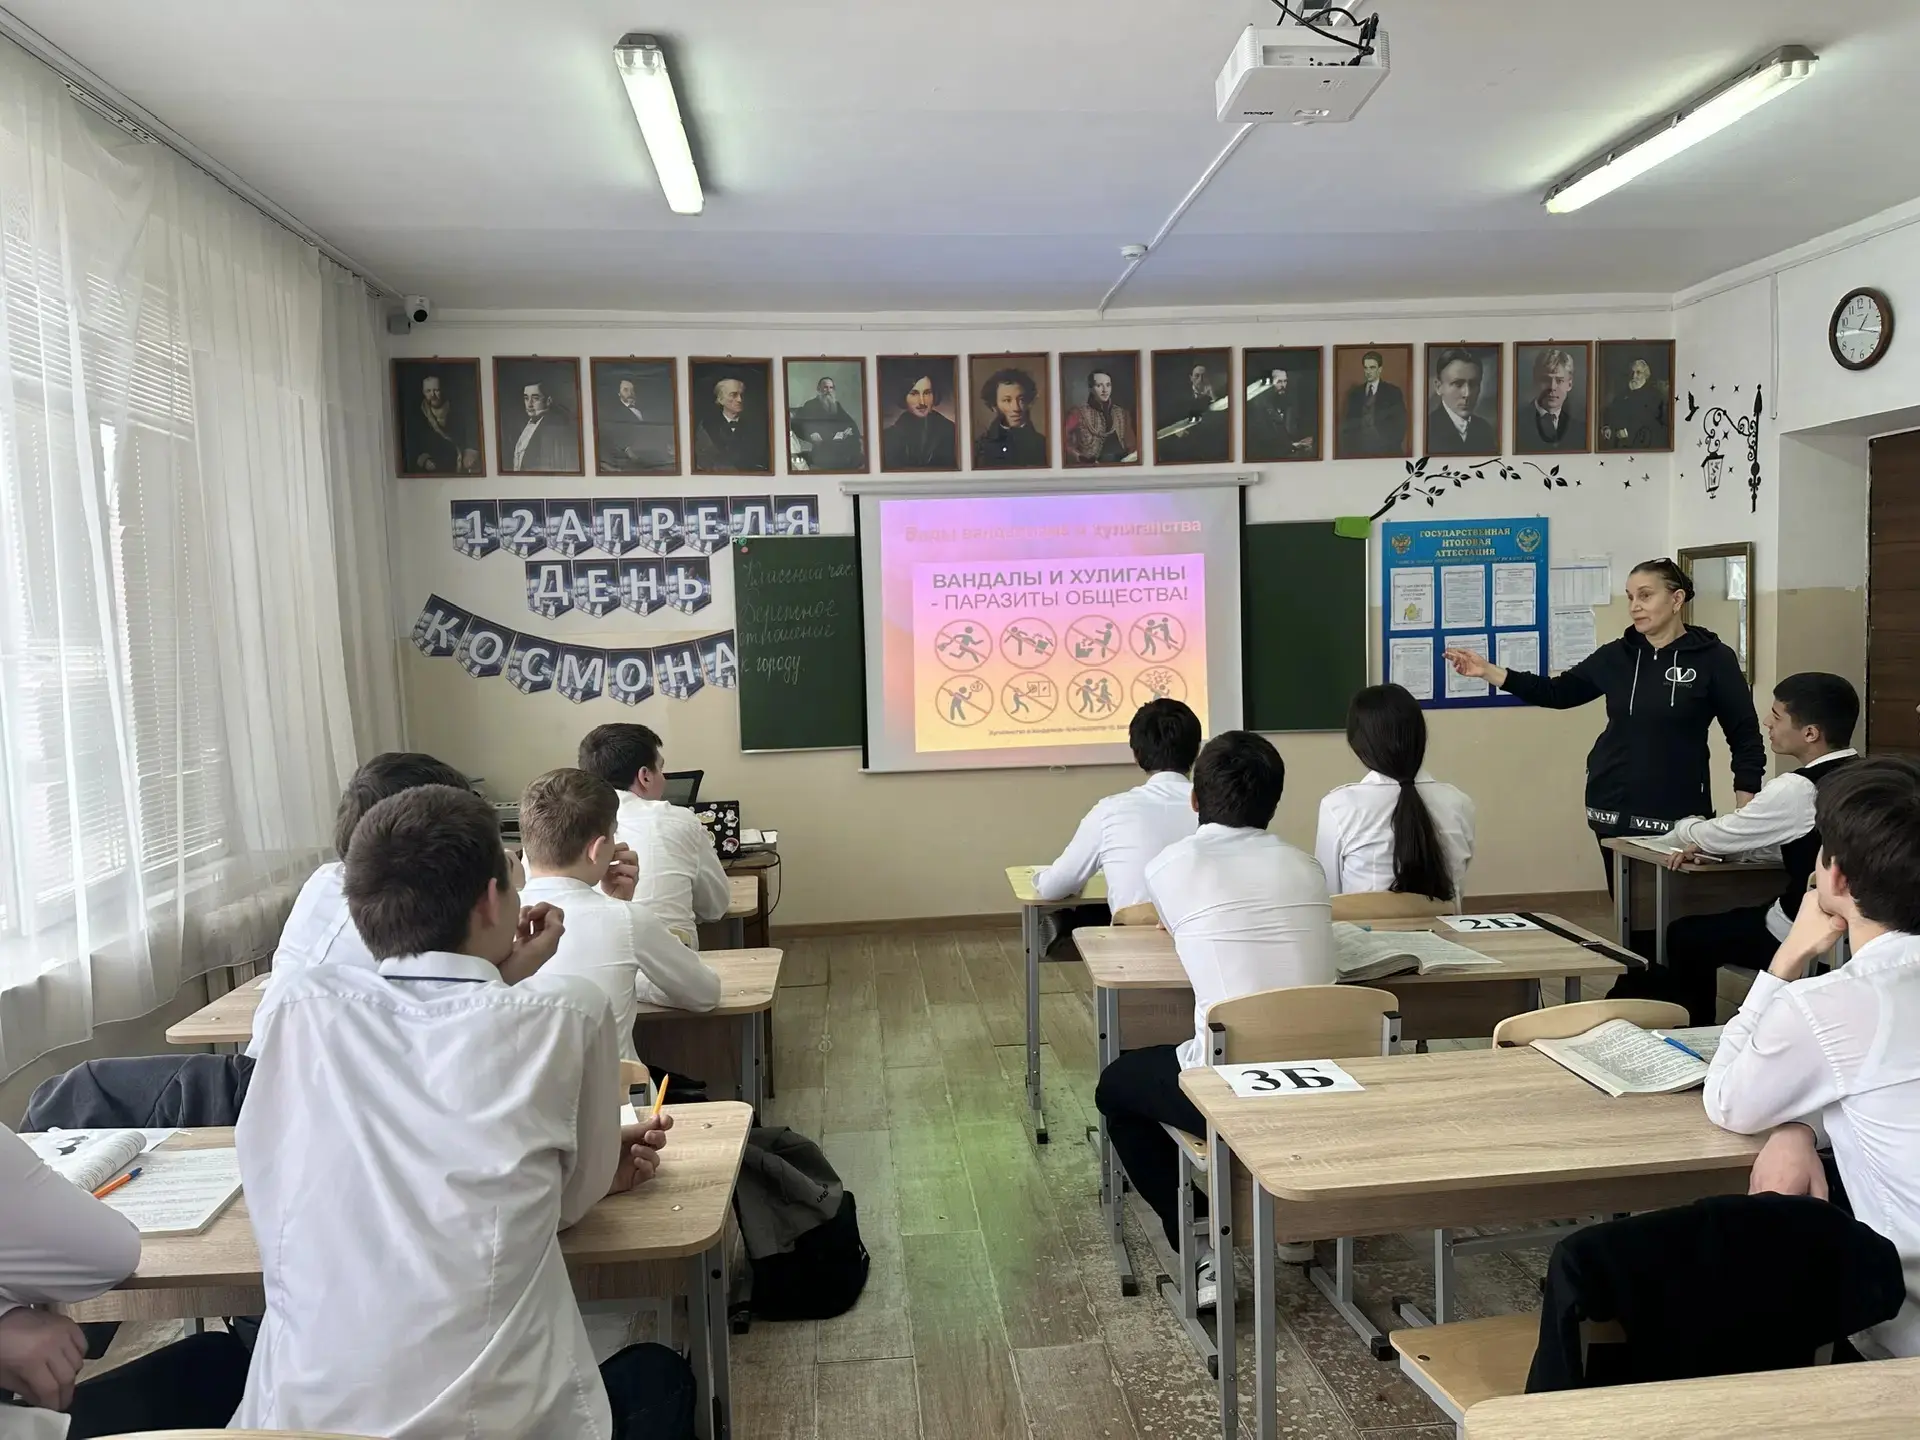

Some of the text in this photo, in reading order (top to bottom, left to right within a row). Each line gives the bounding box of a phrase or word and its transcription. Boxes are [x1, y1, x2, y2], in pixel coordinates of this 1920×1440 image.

[1420, 527, 1511, 538] ГОСУДАРСТВЕННАЯ
[1442, 538, 1492, 547] ИТОГОВАЯ
[1435, 548, 1496, 558] АТТЕСТАЦИЯ
[932, 566, 1185, 590] ВАНДАЛЫ И ХУЛИГАНЫ
[534, 564, 703, 606] ДЕНЬ
[945, 591, 1059, 610] ПАРАЗИТЫ
[1065, 587, 1188, 608] ОБЩЕСТВА!
[425, 608, 736, 694] КОСМОНА
[1594, 811, 1617, 822] VLTN
[1635, 818, 1669, 831] VLTN
[1459, 917, 1527, 930] 2Б
[1241, 1067, 1335, 1091] 3Б
